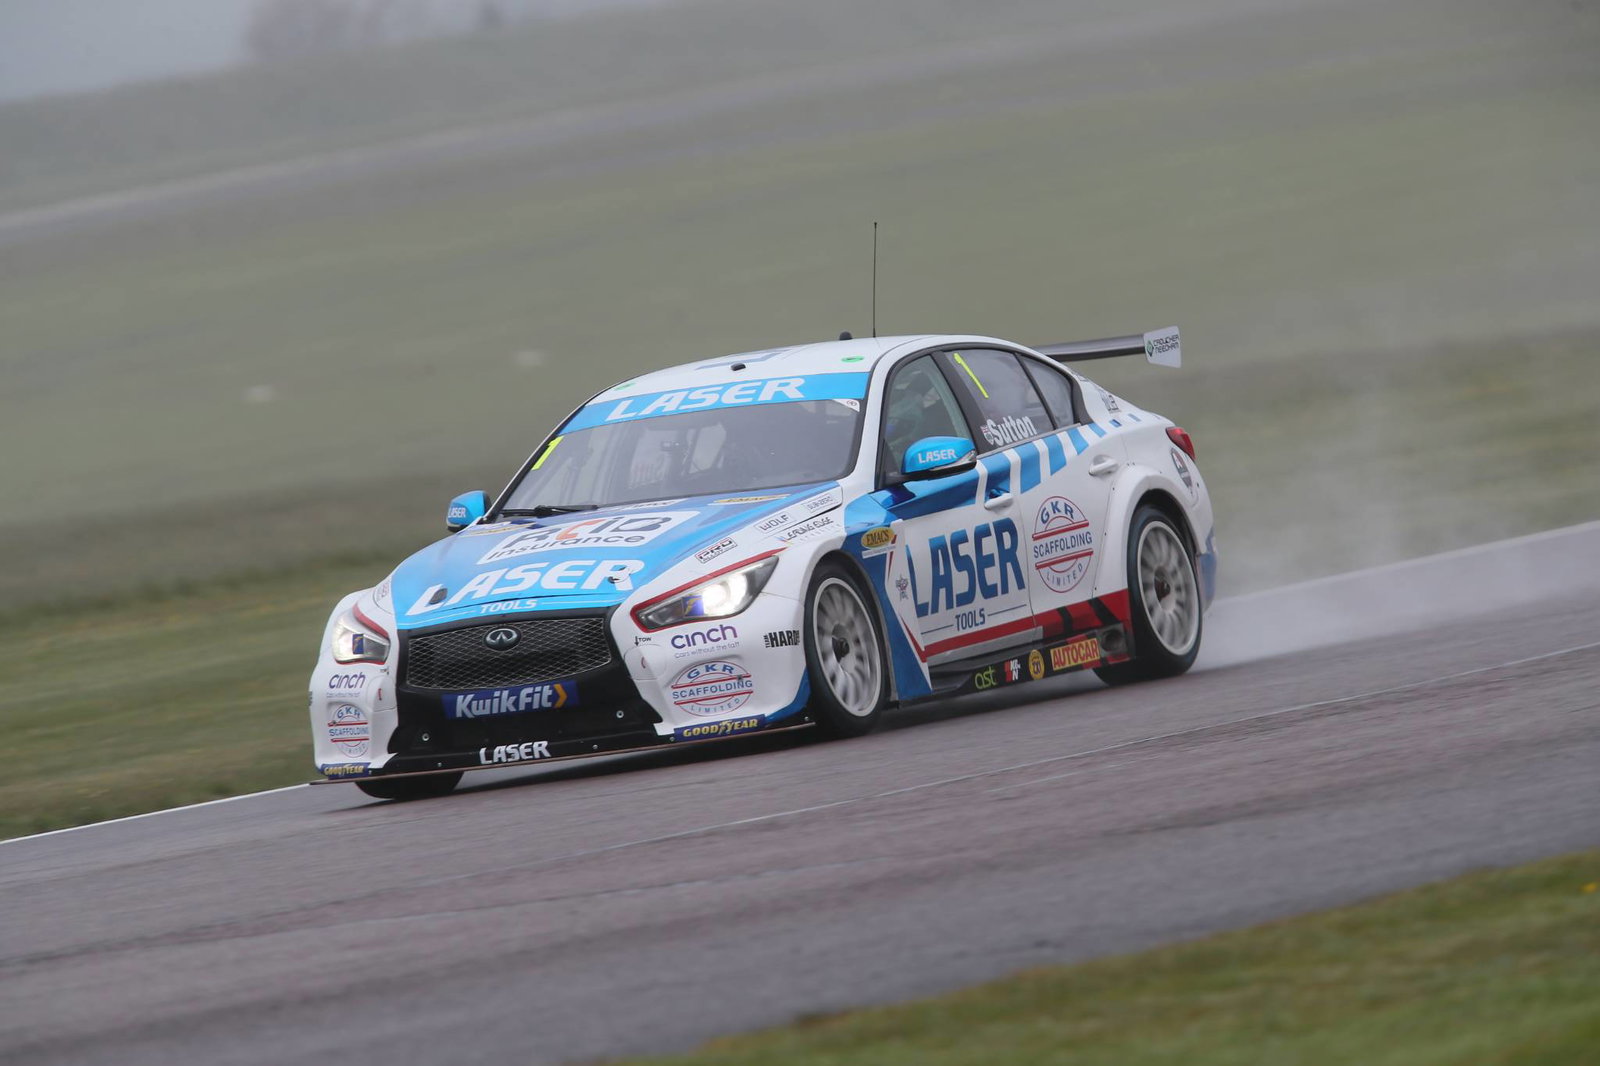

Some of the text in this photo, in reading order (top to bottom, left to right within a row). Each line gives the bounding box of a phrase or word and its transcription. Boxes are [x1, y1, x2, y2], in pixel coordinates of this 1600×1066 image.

[604, 378, 805, 421] LASER
[986, 415, 1037, 446] Sutton
[531, 435, 564, 471] 1
[917, 449, 957, 464] LASER
[448, 507, 467, 518] LASER
[760, 514, 789, 531] WOLF
[813, 516, 834, 530] EDGE
[1041, 501, 1074, 524] GKR
[866, 529, 890, 546] EMACS
[1033, 531, 1093, 558] SCAFFOLDING
[904, 516, 1026, 618] LASER
[1046, 563, 1082, 586] LIMITED
[405, 559, 645, 616] LASER
[480, 599, 538, 613] TOOLS
[954, 608, 986, 632] TOOLS
[671, 624, 738, 649] cinch
[1053, 642, 1099, 669] AUTOCAR
[328, 672, 366, 689] cinch
[687, 663, 734, 679] GKR
[672, 680, 753, 699] SCAFFOLDING
[691, 698, 740, 713] LIMITED
[683, 718, 758, 738] GOODYEAR
[479, 740, 552, 765] LASER
